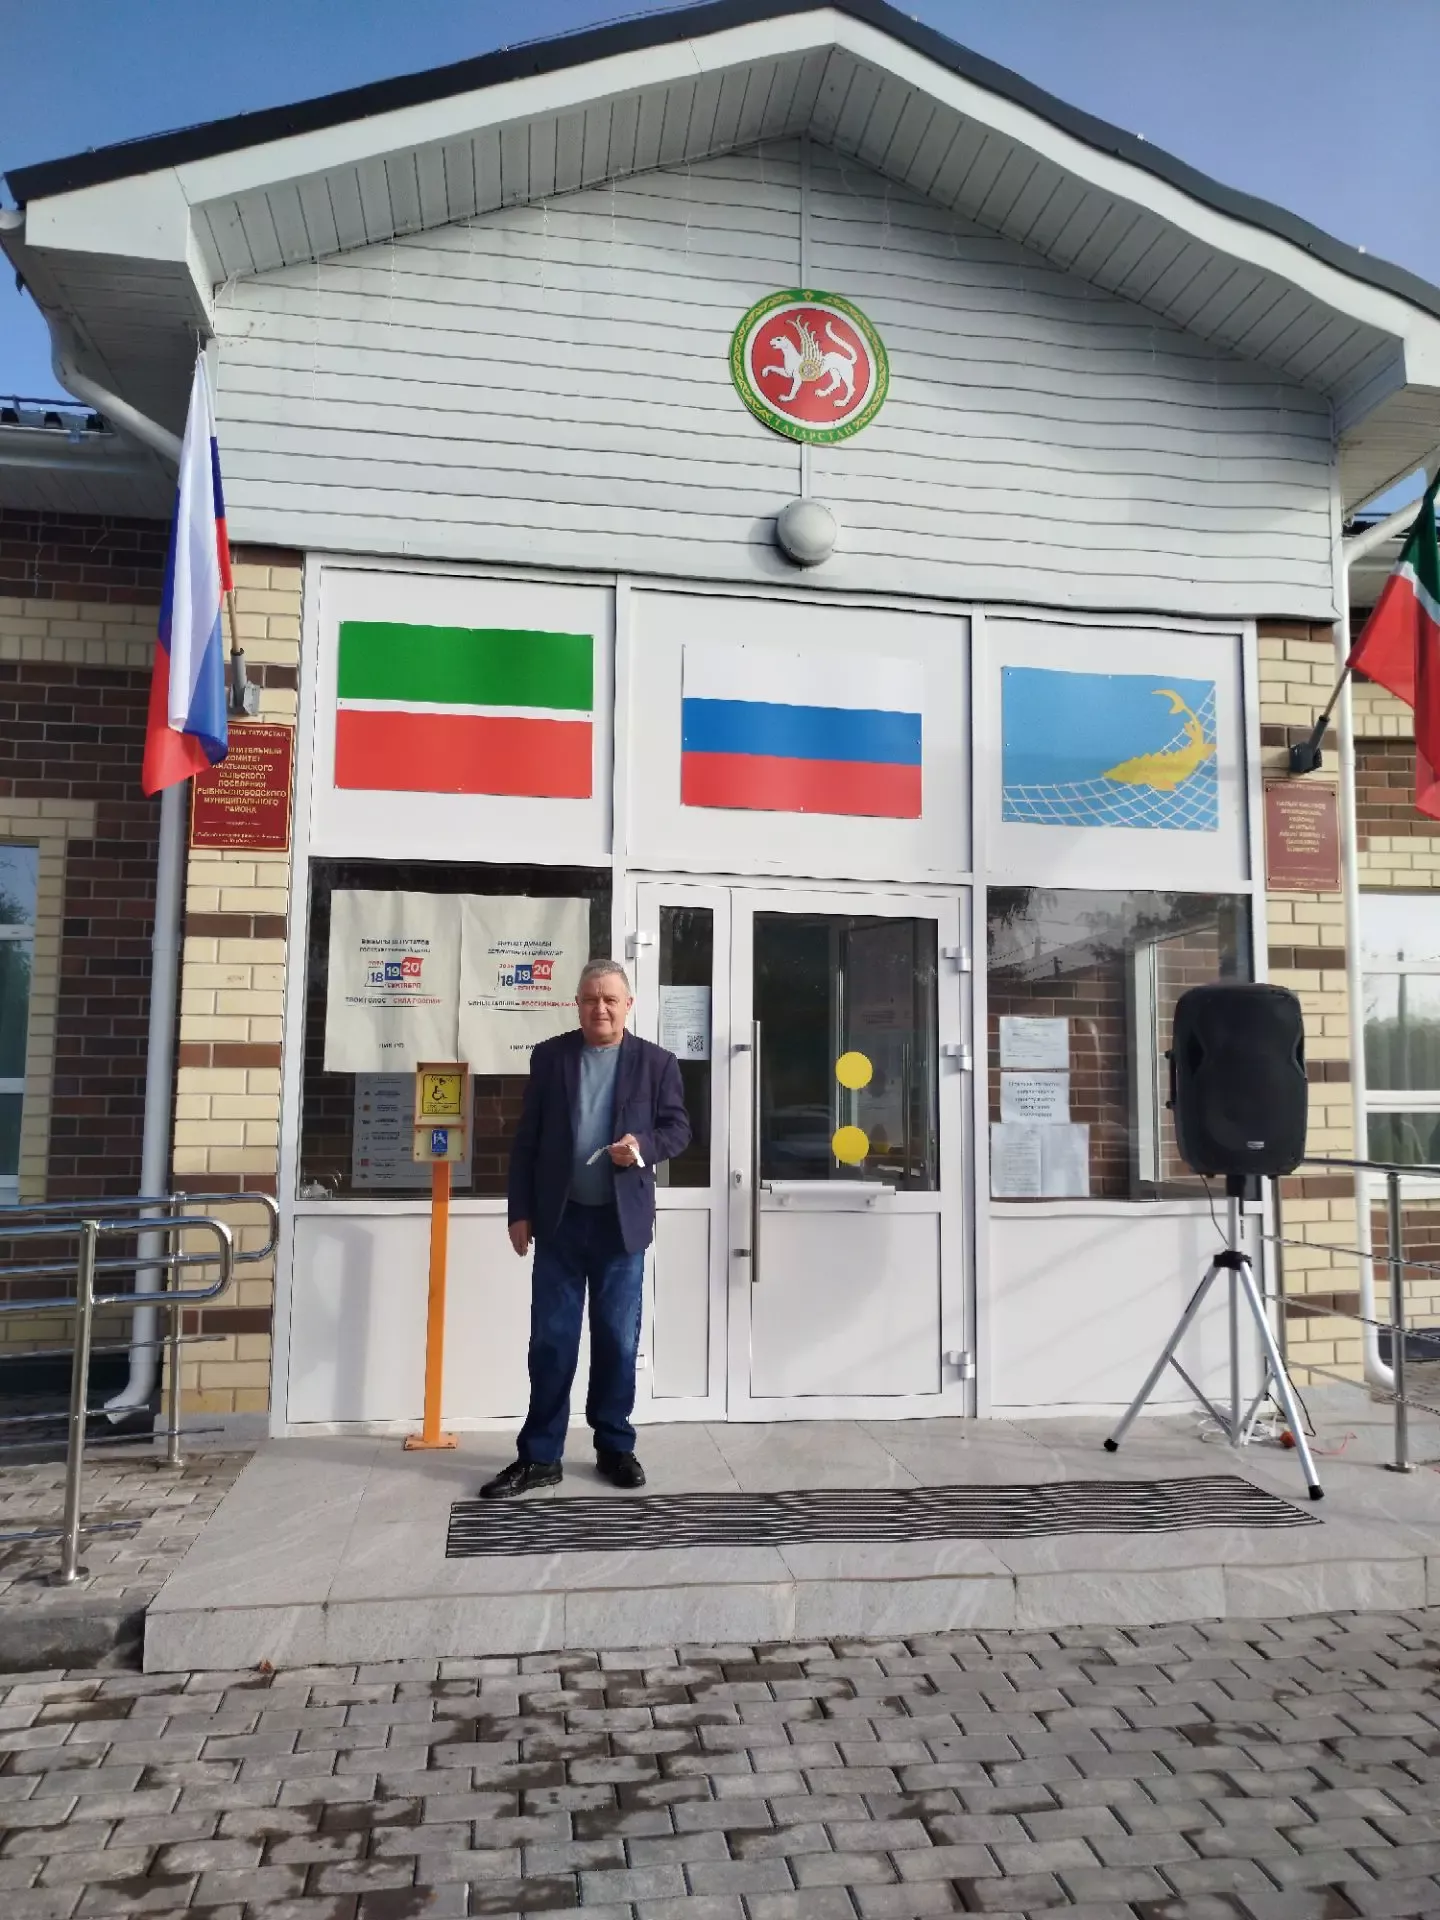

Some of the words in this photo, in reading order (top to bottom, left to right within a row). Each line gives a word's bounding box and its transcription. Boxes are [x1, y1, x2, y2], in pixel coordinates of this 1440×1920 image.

[775, 420, 854, 441] ТАТАРСТАН
[219, 772, 266, 780] СЕЛЬСКОГО
[218, 780, 267, 788] ПОСЕЛЕНИЯ
[203, 797, 280, 807] МУНИЦИПАЛЬНОГО
[224, 805, 257, 814] РАЙОНА
[370, 971, 384, 983] 18
[386, 965, 400, 977] 19
[402, 961, 420, 973] 20
[500, 974, 514, 987] 18
[516, 969, 531, 981] 19
[533, 964, 551, 976] 20
